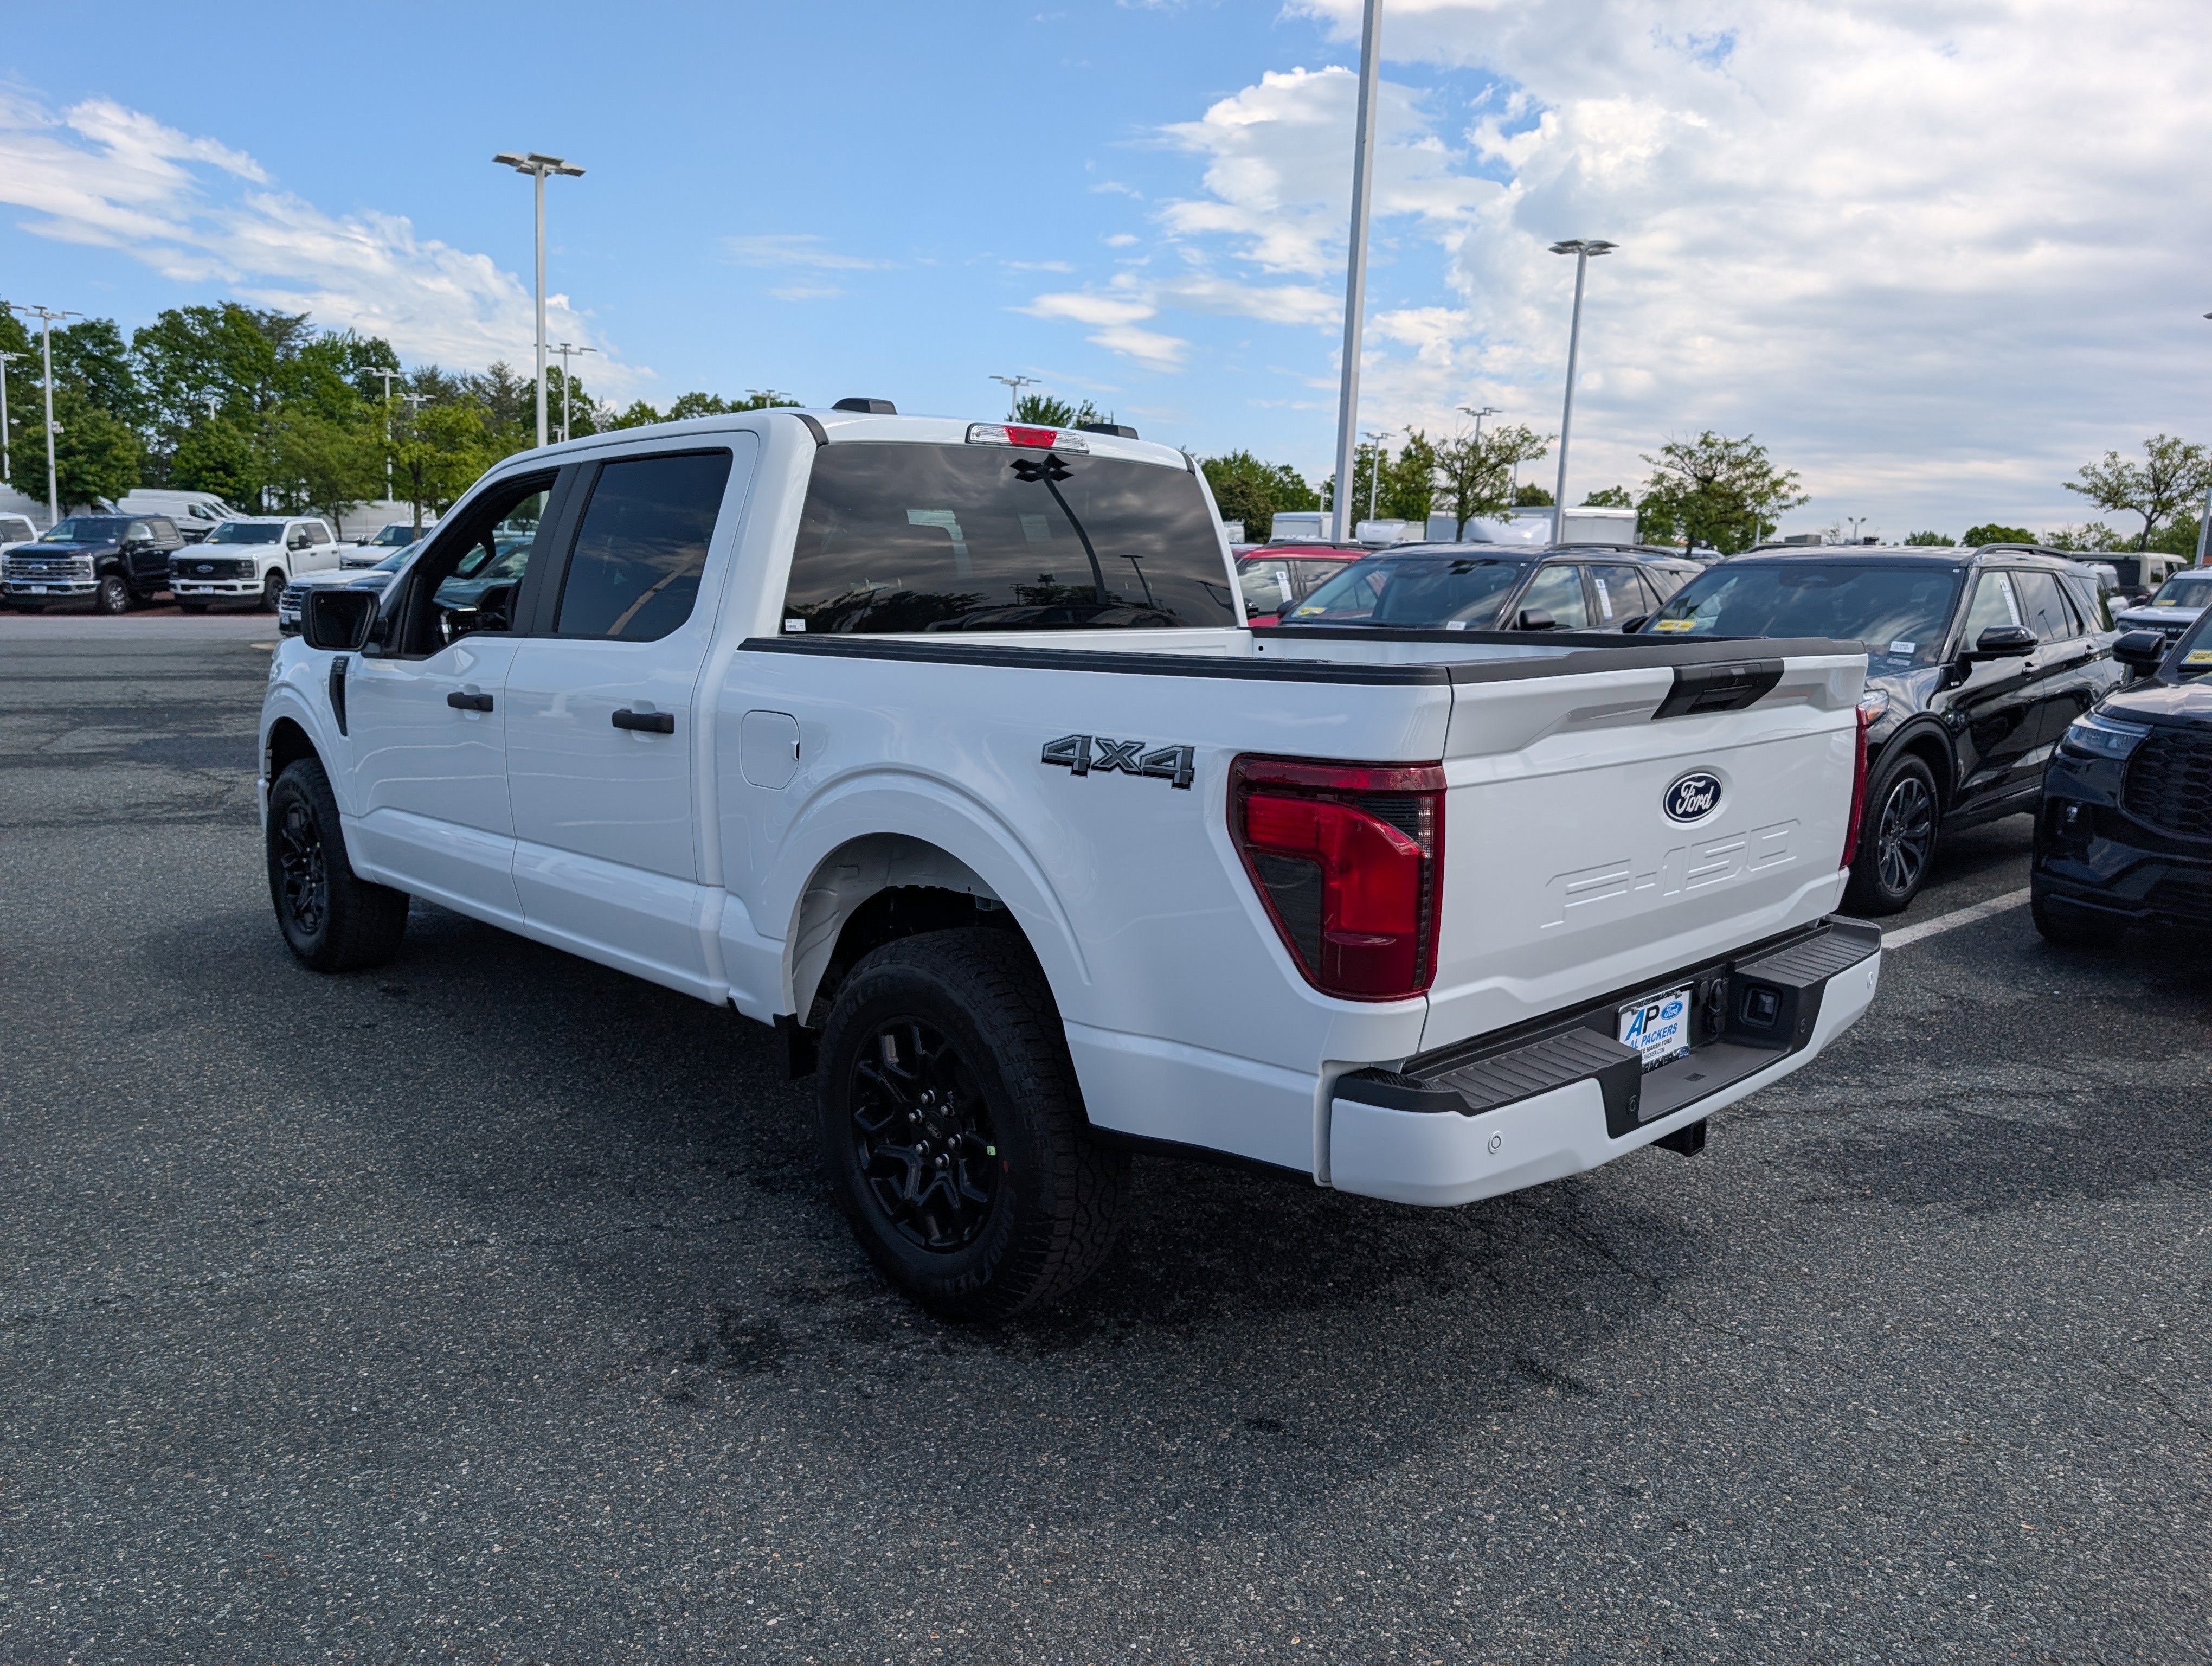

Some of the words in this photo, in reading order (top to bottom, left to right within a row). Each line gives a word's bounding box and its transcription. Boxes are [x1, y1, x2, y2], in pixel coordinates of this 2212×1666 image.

[1675, 779, 1715, 815] Ford
[1540, 818, 1801, 928] F-150
[1624, 1005, 1660, 1041] AP
[1663, 1003, 1680, 1018] Ford
[1641, 1022, 1678, 1047] PACKERS
[1647, 1042, 1660, 1052] MARSH
[1662, 1037, 1672, 1046] FORD
